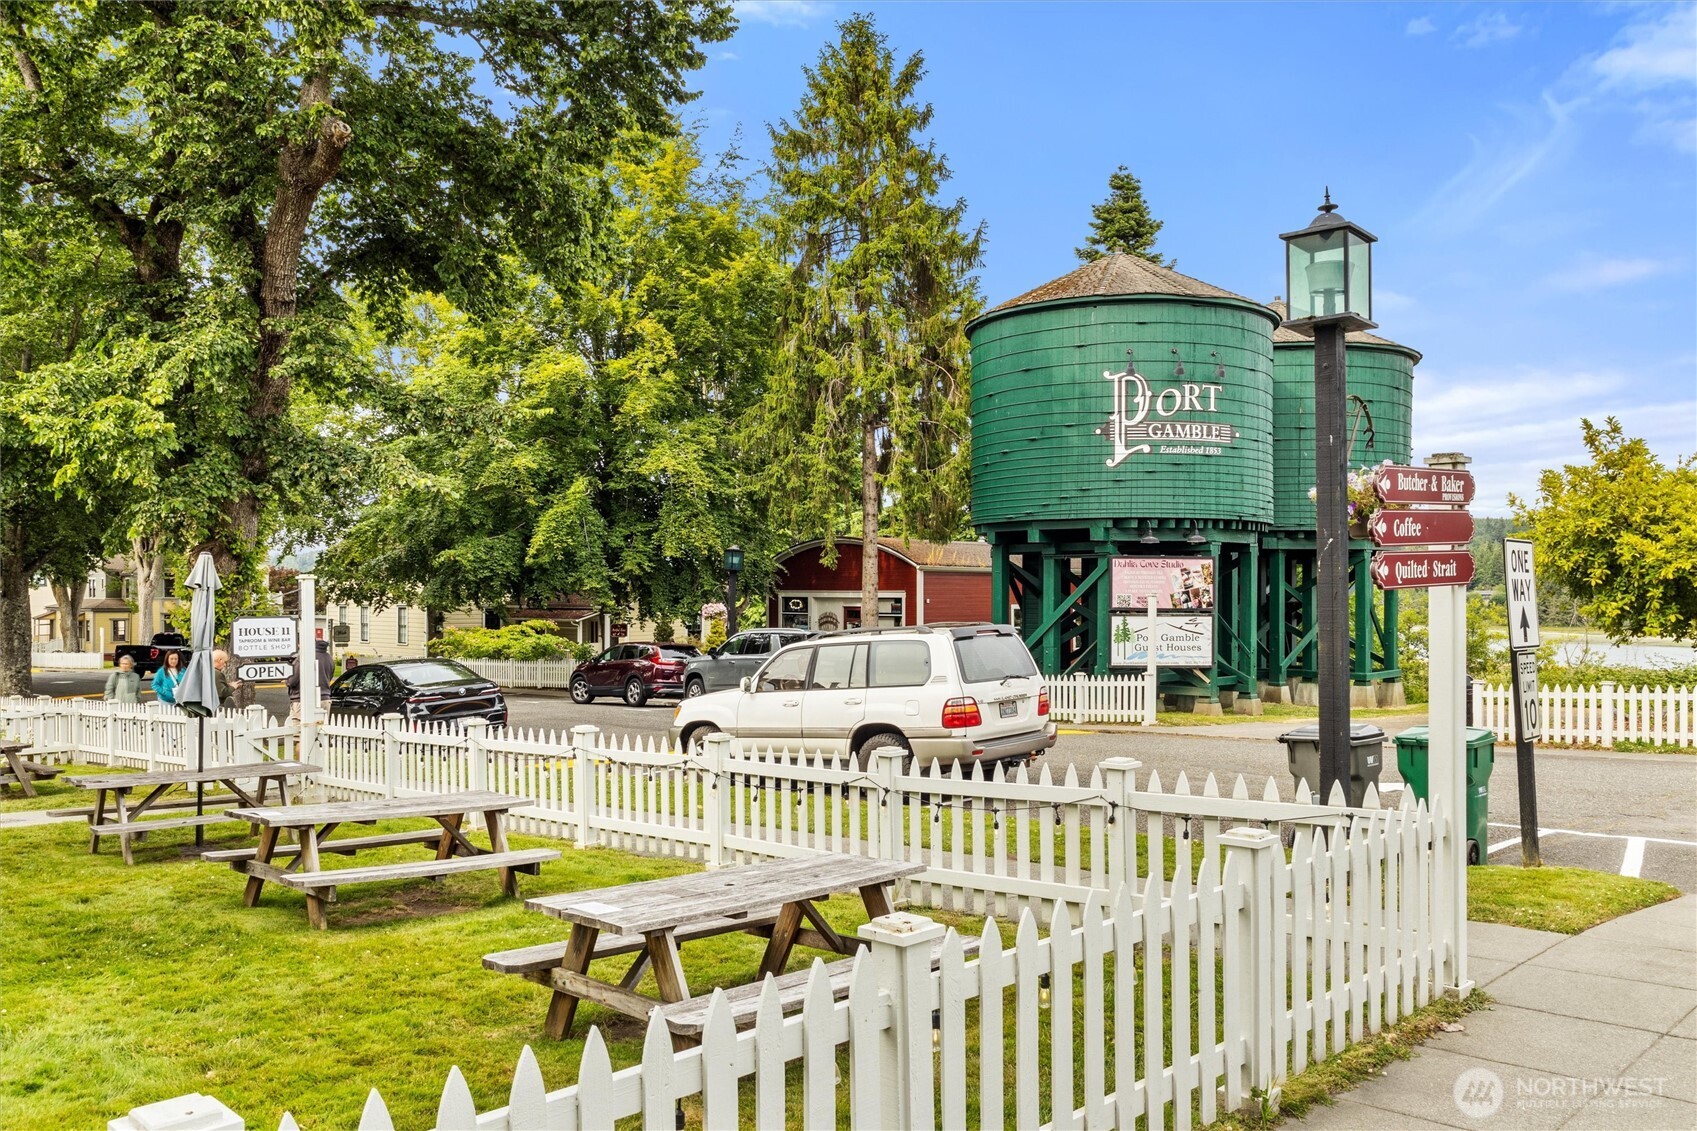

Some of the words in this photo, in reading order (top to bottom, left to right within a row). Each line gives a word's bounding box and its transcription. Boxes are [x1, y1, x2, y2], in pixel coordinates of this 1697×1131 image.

[1103, 371, 1223, 466] PORT
[1148, 423, 1221, 440] GAMBLE
[1160, 445, 1204, 454] Established
[1397, 472, 1428, 491] Butcher
[1431, 475, 1438, 492] &
[1441, 475, 1465, 492] Baker
[1393, 517, 1421, 537] Coffee
[1139, 560, 1159, 568] Cove
[1161, 560, 1184, 568] Studio
[1511, 549, 1530, 573] ONE
[1395, 559, 1428, 584] Quilted
[1433, 559, 1457, 577] Strait
[1511, 578, 1531, 602] WAY
[238, 627, 280, 637] HOUSE
[1161, 633, 1200, 642] Gamble
[1134, 643, 1162, 652] Gust
[1166, 643, 1202, 652] Houses
[245, 665, 285, 679] OPEN
[1520, 661, 1535, 674] SPEED
[1523, 680, 1535, 693] LIMIT
[1524, 698, 1537, 731] 10
